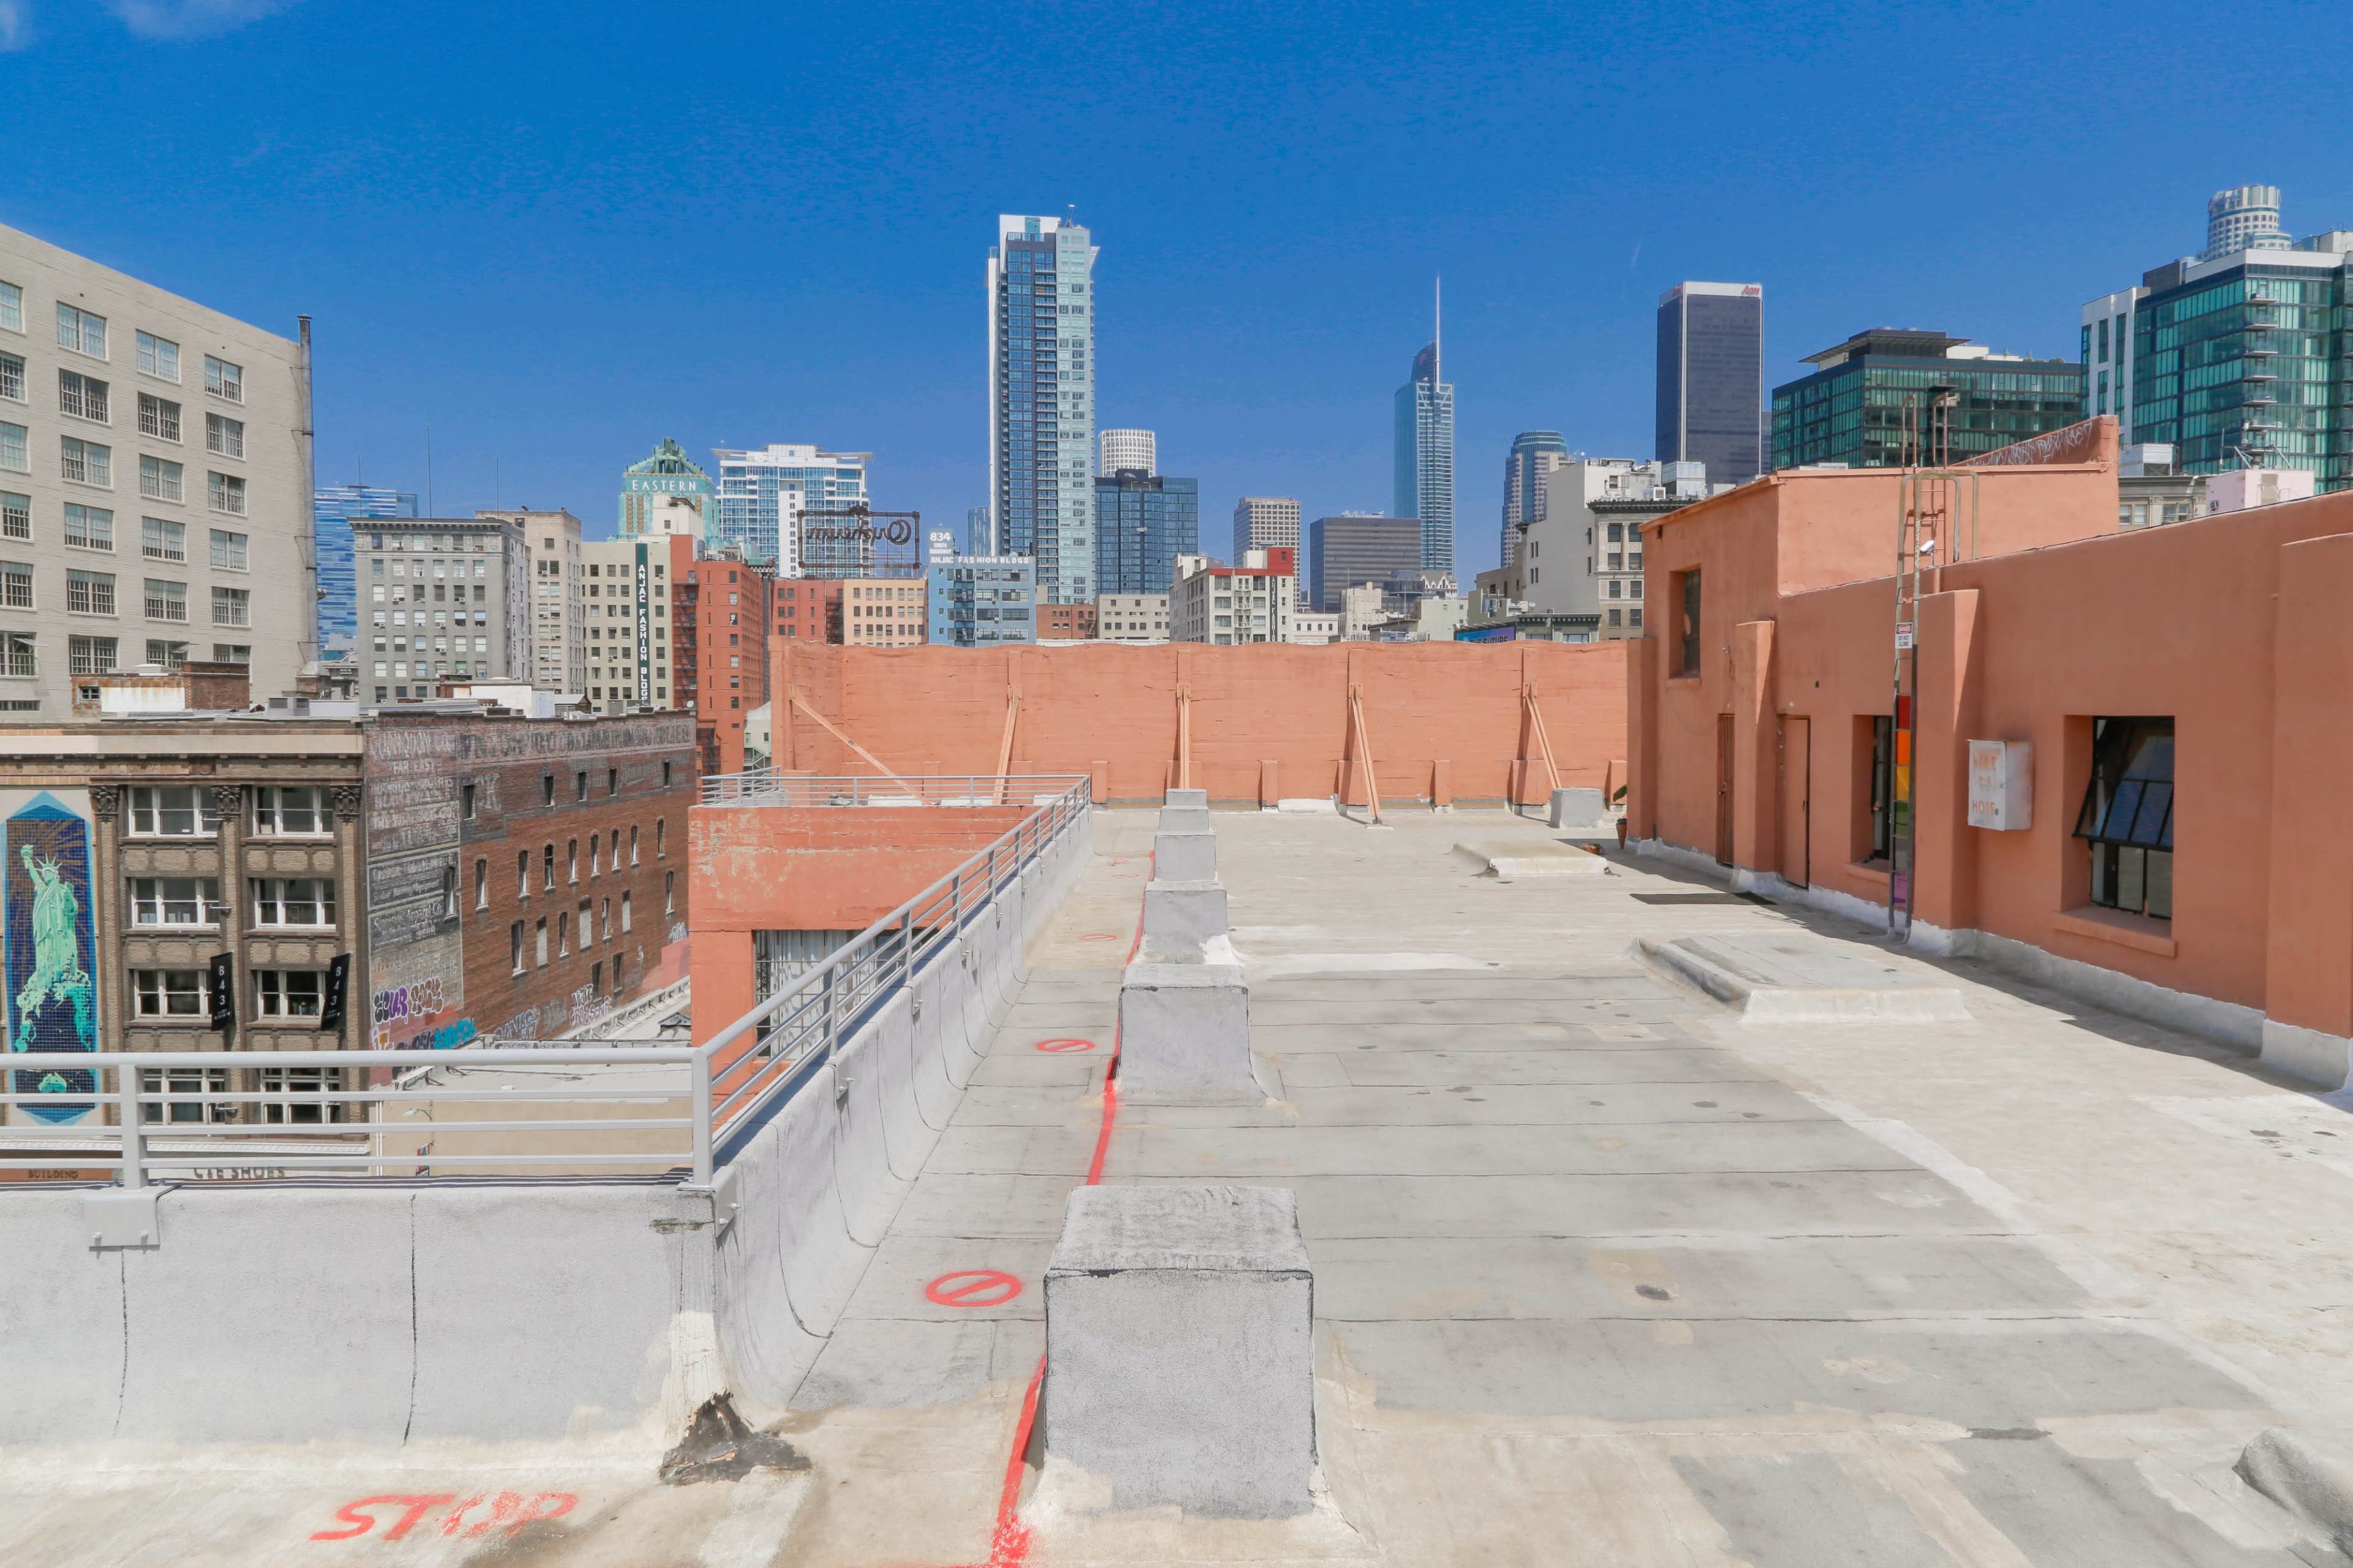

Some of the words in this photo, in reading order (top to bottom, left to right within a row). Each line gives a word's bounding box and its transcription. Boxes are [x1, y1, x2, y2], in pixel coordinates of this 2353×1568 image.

[632, 480, 696, 490] EASTERN
[930, 532, 951, 541] 834
[330, 966, 341, 1006] 843
[28, 1170, 78, 1179] BUILDING
[309, 1490, 578, 1540] STOP
